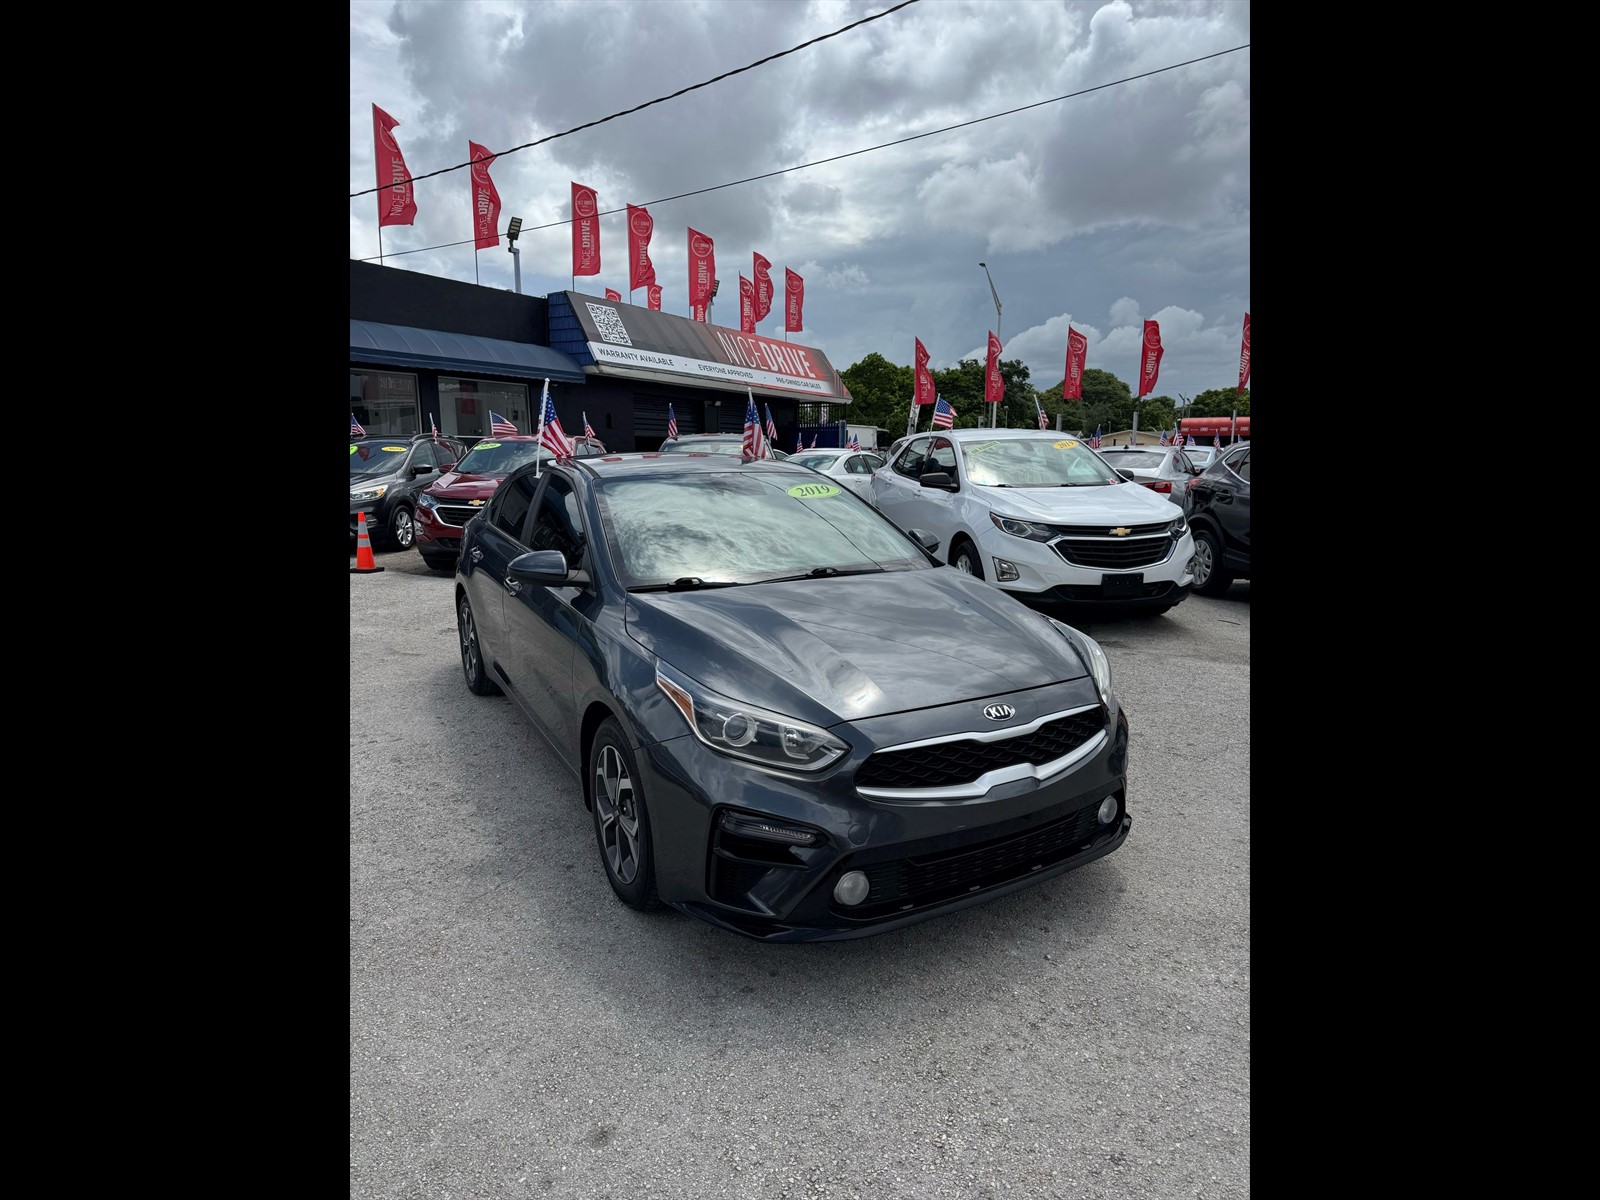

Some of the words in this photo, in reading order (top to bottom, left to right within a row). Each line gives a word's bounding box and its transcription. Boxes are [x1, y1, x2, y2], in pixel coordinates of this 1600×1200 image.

[391, 157, 406, 194] DRIVE
[390, 195, 406, 216] NICE
[478, 187, 491, 215] DRIVE
[581, 220, 591, 248] DRIVE
[581, 249, 591, 269] NICE
[698, 260, 707, 283] DRIVE
[597, 347, 638, 361] WARRANTY
[639, 356, 675, 367] AVAILABLE
[796, 485, 830, 497] 2019
[987, 704, 1012, 718] KIA
